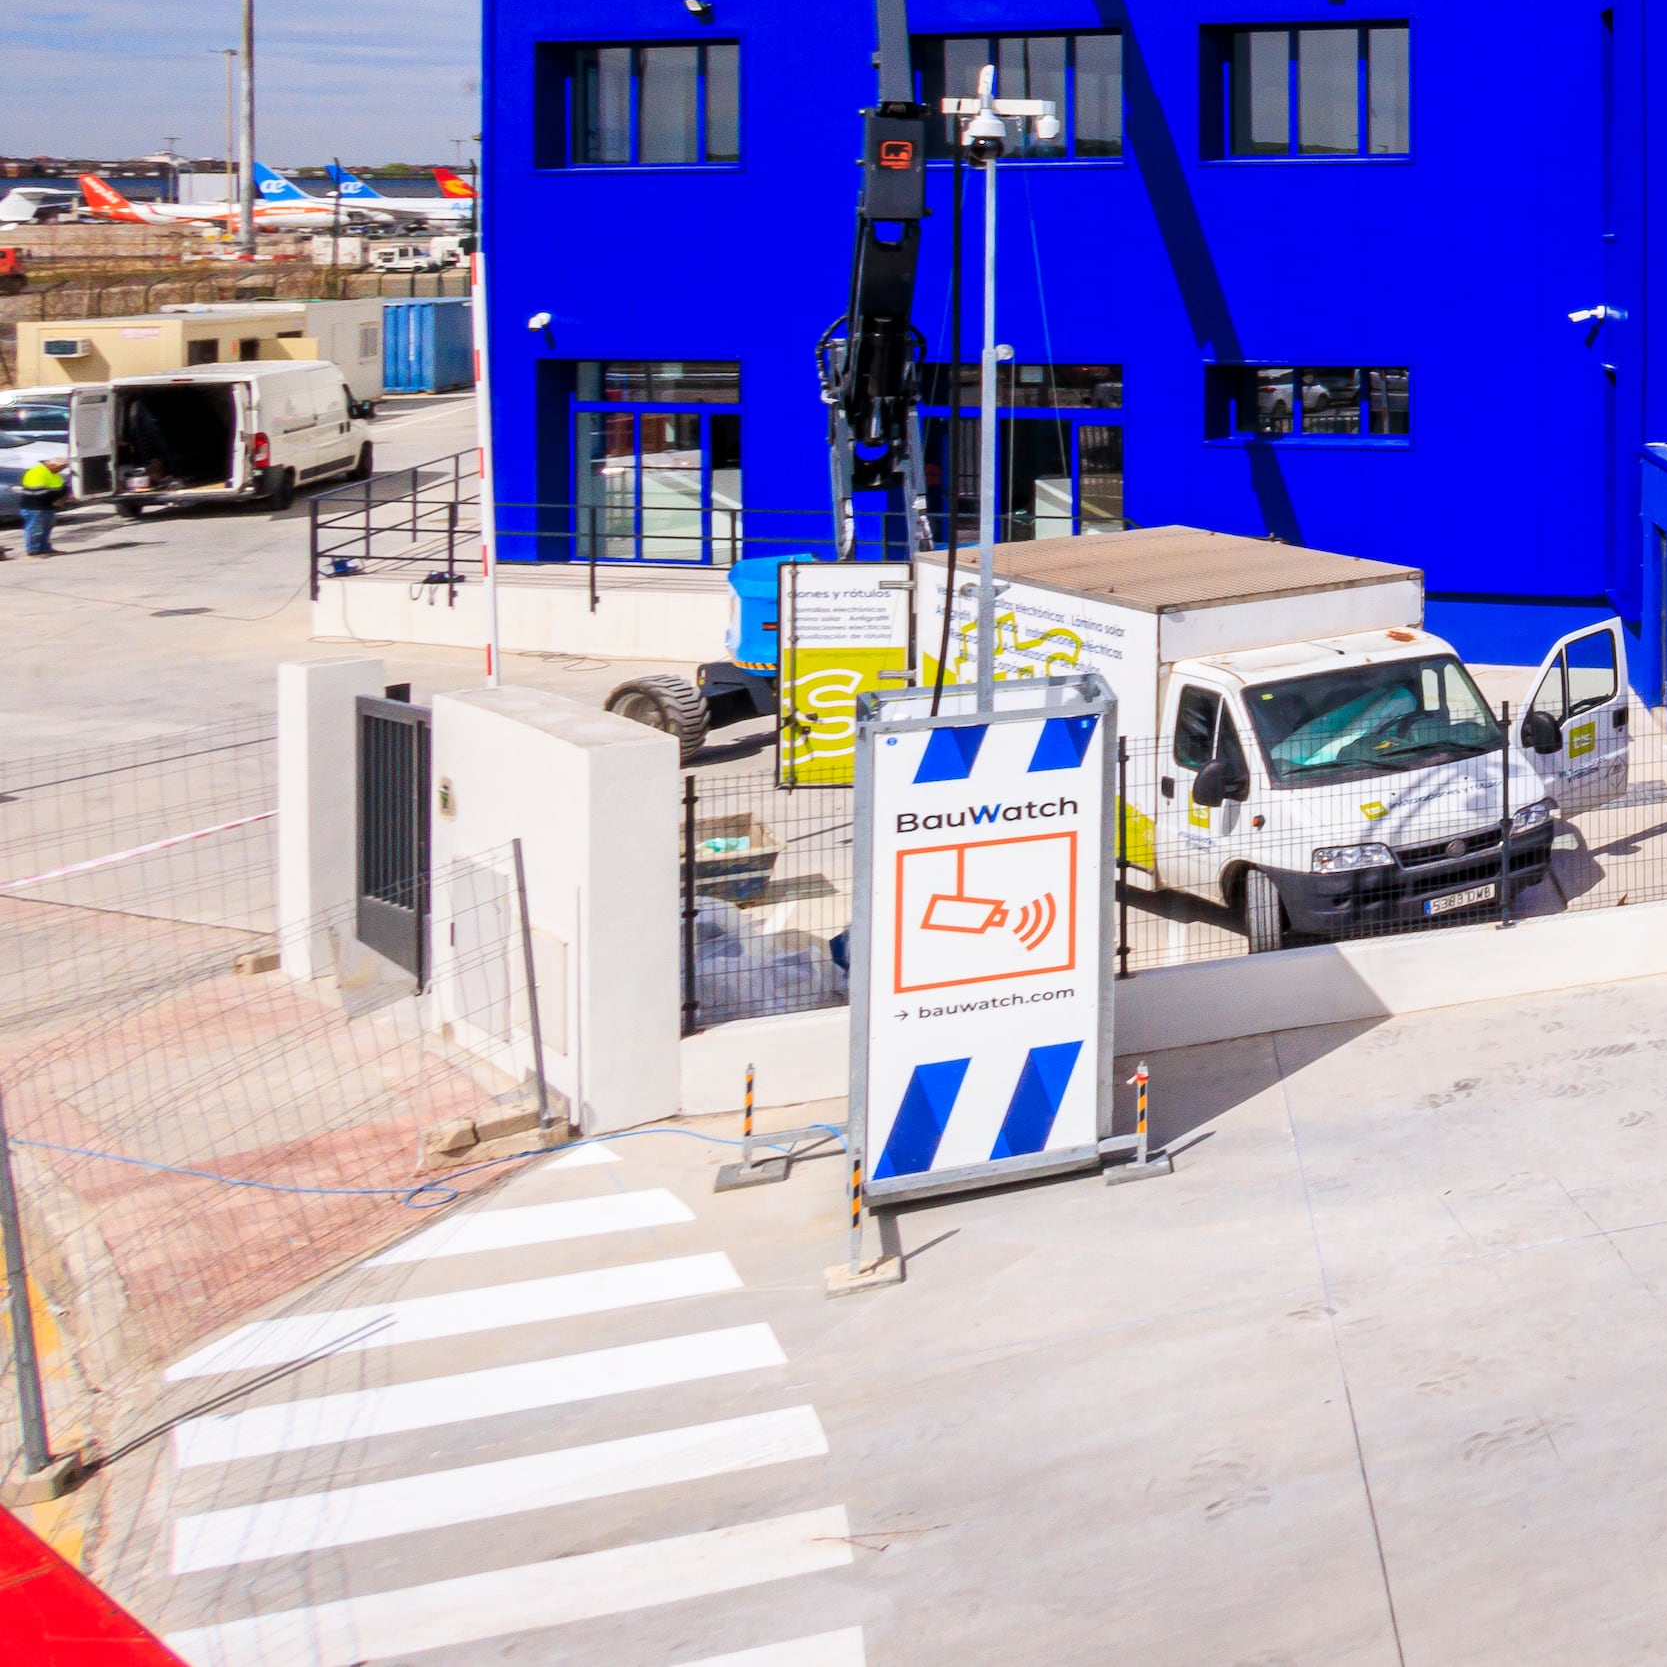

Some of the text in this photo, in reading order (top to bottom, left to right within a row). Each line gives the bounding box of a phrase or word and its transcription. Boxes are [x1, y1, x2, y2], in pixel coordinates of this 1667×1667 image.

[787, 590, 830, 598] cones
[896, 796, 1079, 833] BauWatch
[918, 987, 1076, 1019] bauwatch.com
